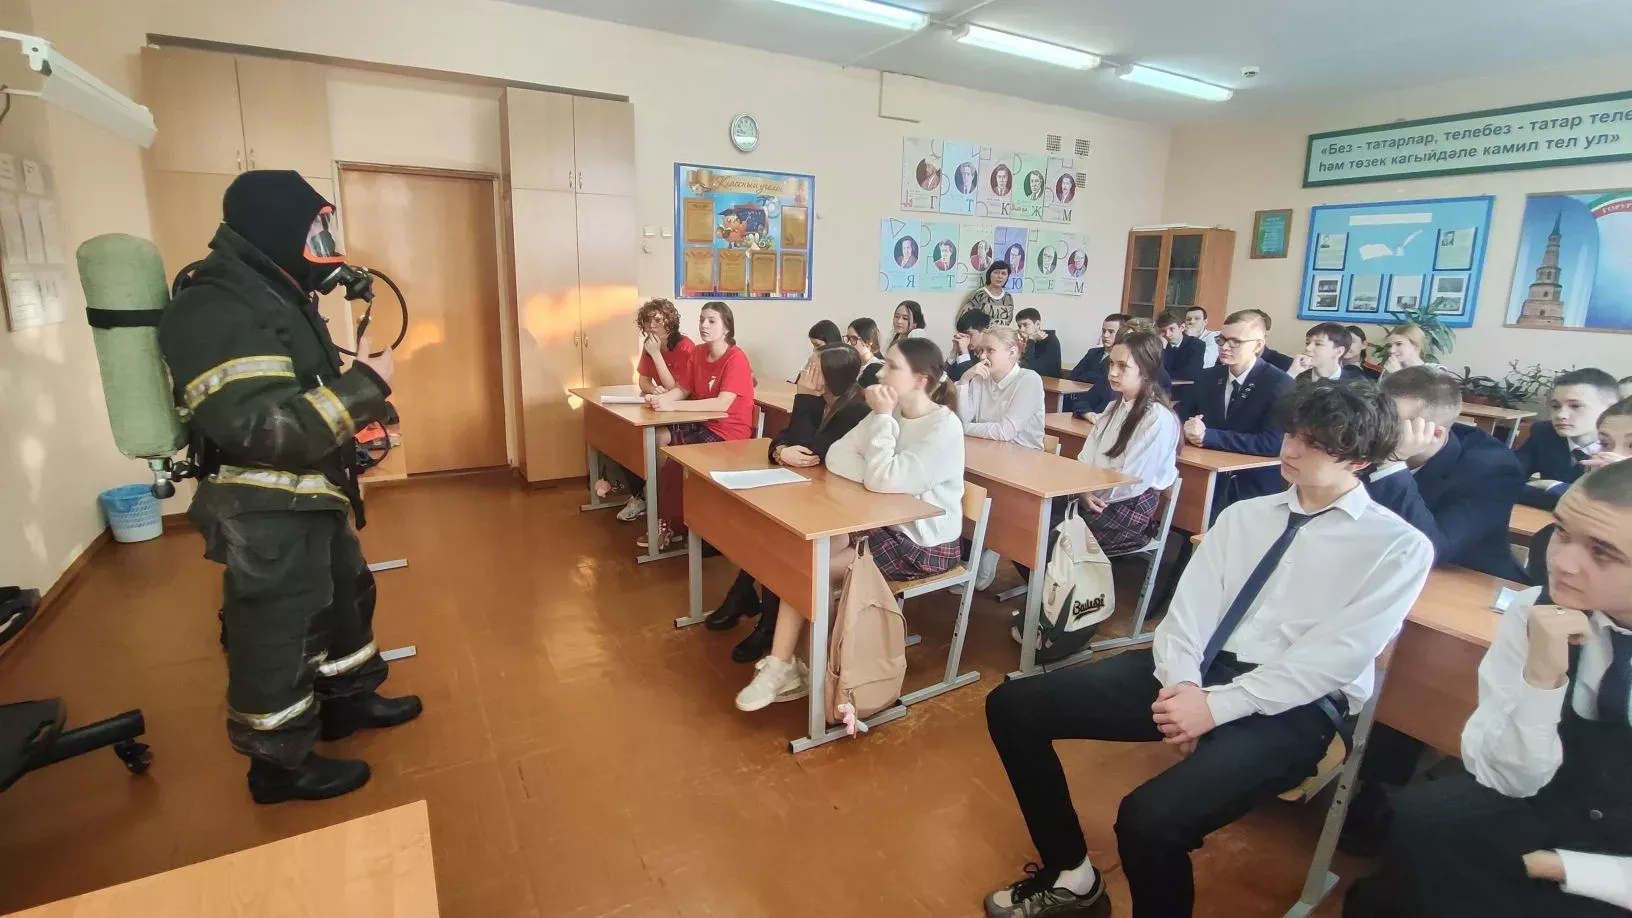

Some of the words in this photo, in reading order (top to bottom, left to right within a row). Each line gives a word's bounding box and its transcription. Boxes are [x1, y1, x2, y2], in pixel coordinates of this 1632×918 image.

[1321, 143, 1353, 155] «Без
[1365, 133, 1438, 151] татарлар,
[1444, 123, 1511, 141] телебез
[1529, 115, 1582, 130] татар
[1349, 157, 1387, 169] төзек
[1482, 140, 1539, 156] камил
[1545, 136, 1578, 150] тел
[1583, 133, 1620, 150] ул»
